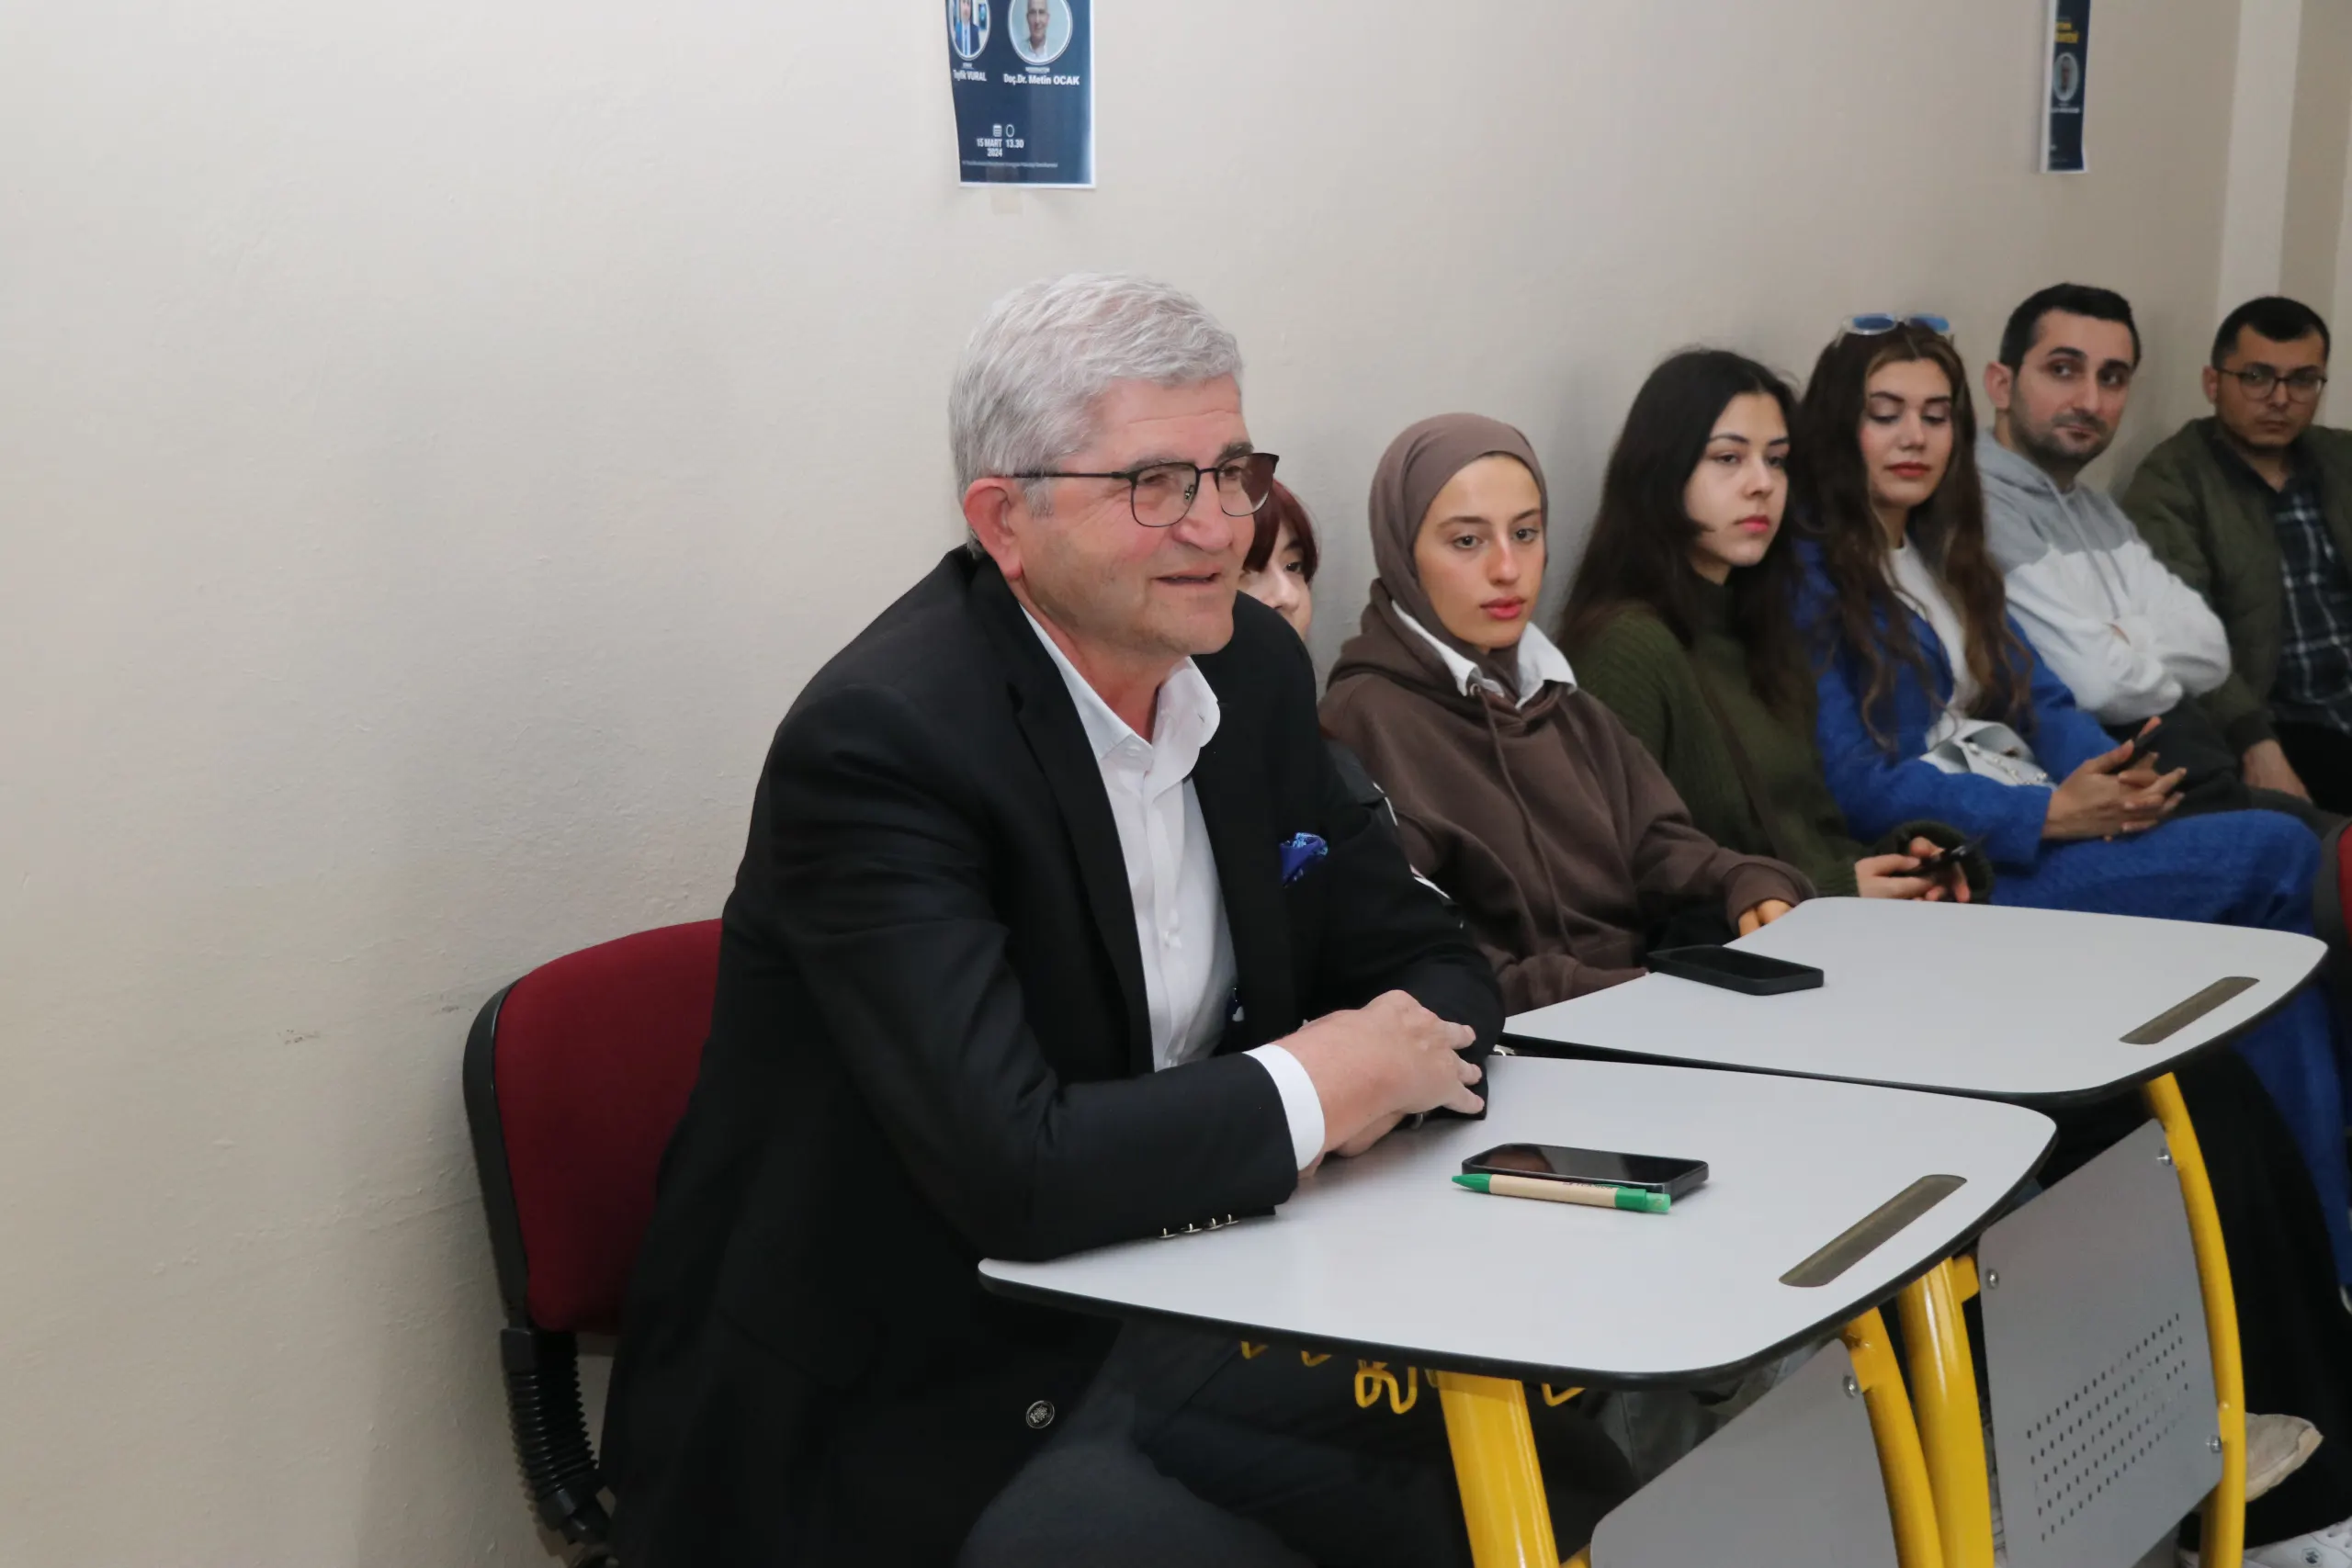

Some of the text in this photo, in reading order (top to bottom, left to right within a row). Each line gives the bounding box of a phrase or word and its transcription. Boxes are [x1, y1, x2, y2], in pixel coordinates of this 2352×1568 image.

[967, 71, 987, 81] VURAL
[1028, 74, 1052, 85] Metin
[1053, 75, 1080, 85] OCAK
[977, 138, 1002, 148] 15 MART
[1006, 139, 1024, 149] 13.30
[987, 148, 1003, 157] 2024
